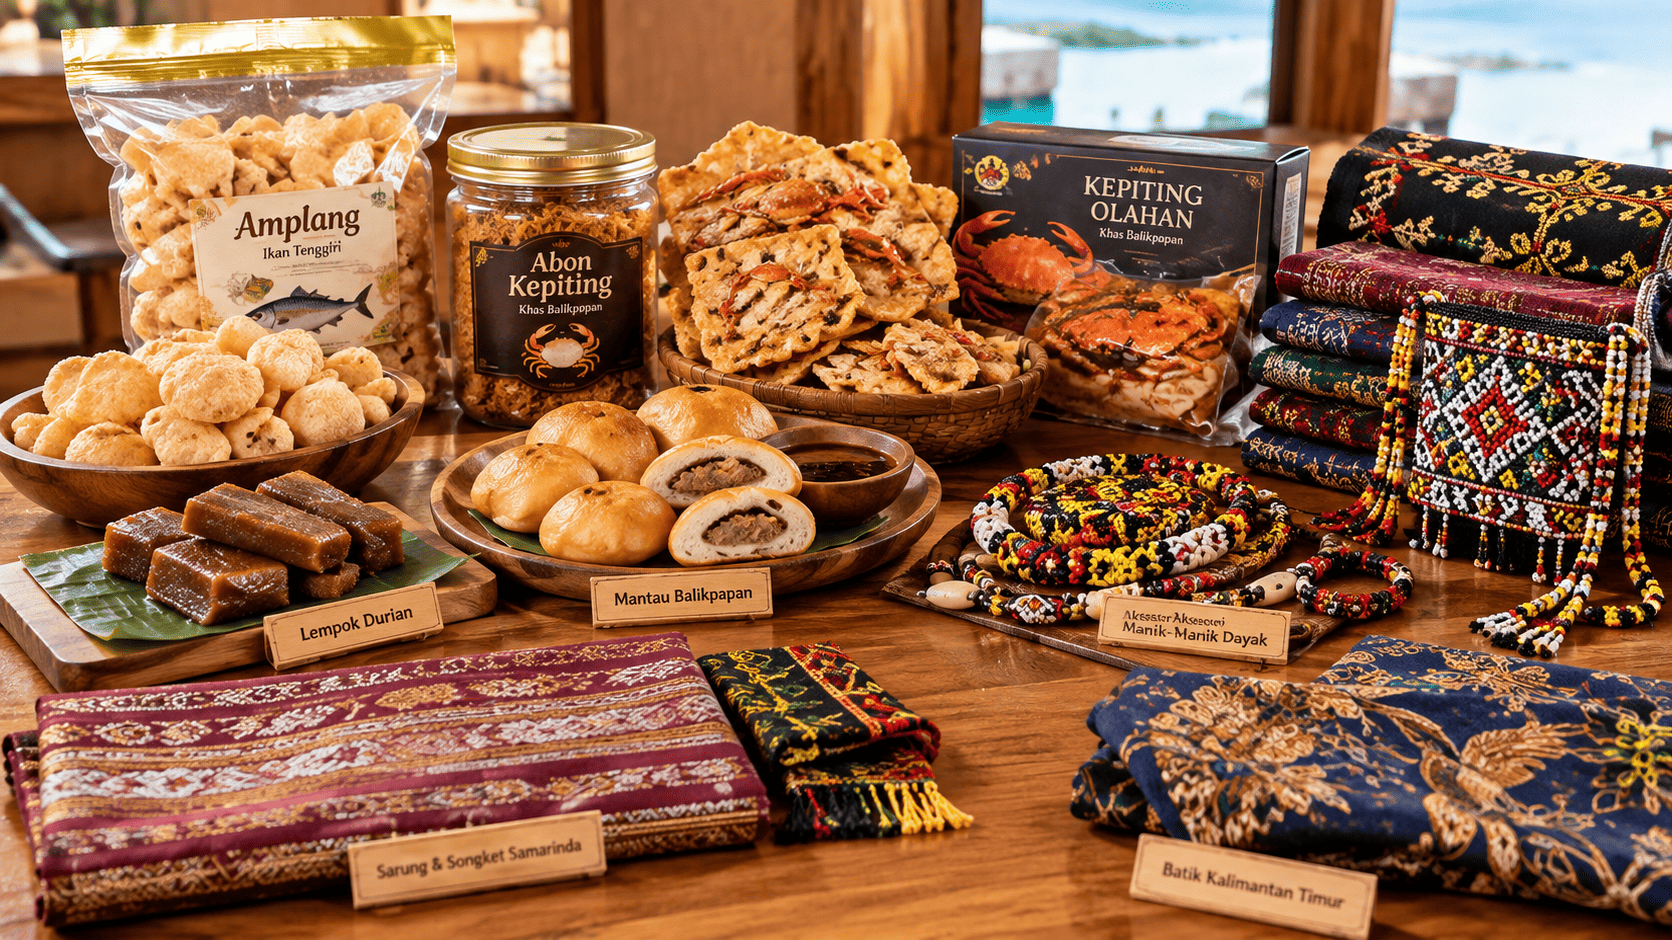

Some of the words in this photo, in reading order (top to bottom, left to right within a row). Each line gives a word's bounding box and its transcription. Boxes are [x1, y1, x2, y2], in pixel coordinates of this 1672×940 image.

[1084, 175, 1204, 206] KEPITING
[234, 204, 360, 243] Amplang
[1090, 201, 1194, 230] OLAHAN
[1099, 227, 1124, 239] Khas
[263, 247, 290, 260] Ikan
[293, 240, 342, 259] Tenggiri
[529, 251, 592, 273] Abon
[508, 273, 613, 303] Kepiting
[614, 591, 670, 606] Mantau
[674, 587, 753, 604] Balikpapan
[300, 616, 361, 641] Lempok
[362, 608, 414, 628] Durian
[1223, 631, 1268, 649] Dayak
[376, 861, 428, 880] Sarung
[432, 857, 443, 871] &
[447, 849, 505, 870] Songket
[508, 838, 582, 862] Samarinda
[1162, 861, 1201, 883] Batik
[1206, 870, 1294, 900] Kalimantan
[1298, 887, 1345, 910] Timur
